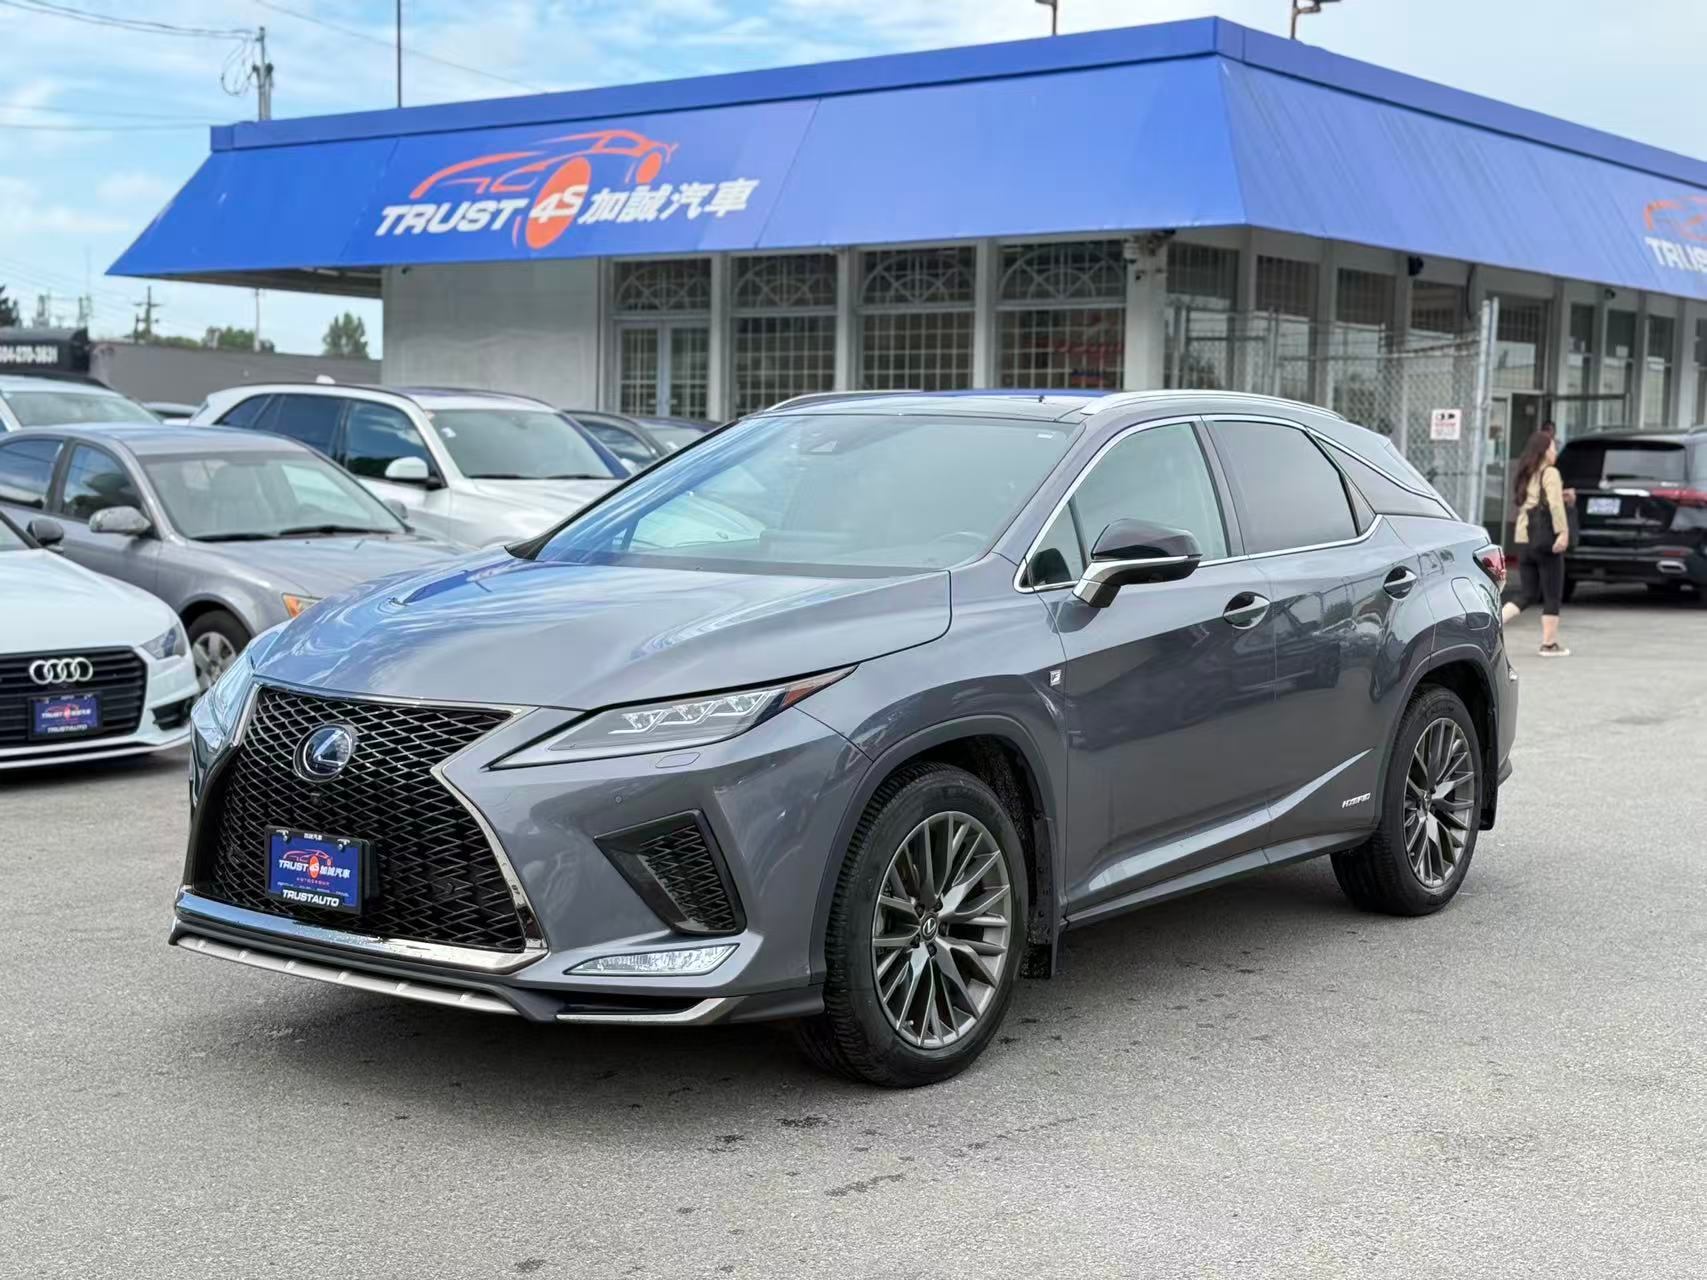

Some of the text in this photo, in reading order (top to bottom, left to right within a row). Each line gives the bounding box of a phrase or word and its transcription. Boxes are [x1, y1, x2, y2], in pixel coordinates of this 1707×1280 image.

[375, 178, 760, 236] TRUST 4S 加誠汽車
[1644, 236, 1707, 273] TRUS
[279, 859, 308, 872] TRUST
[282, 889, 340, 907] TRUSTAUTO
